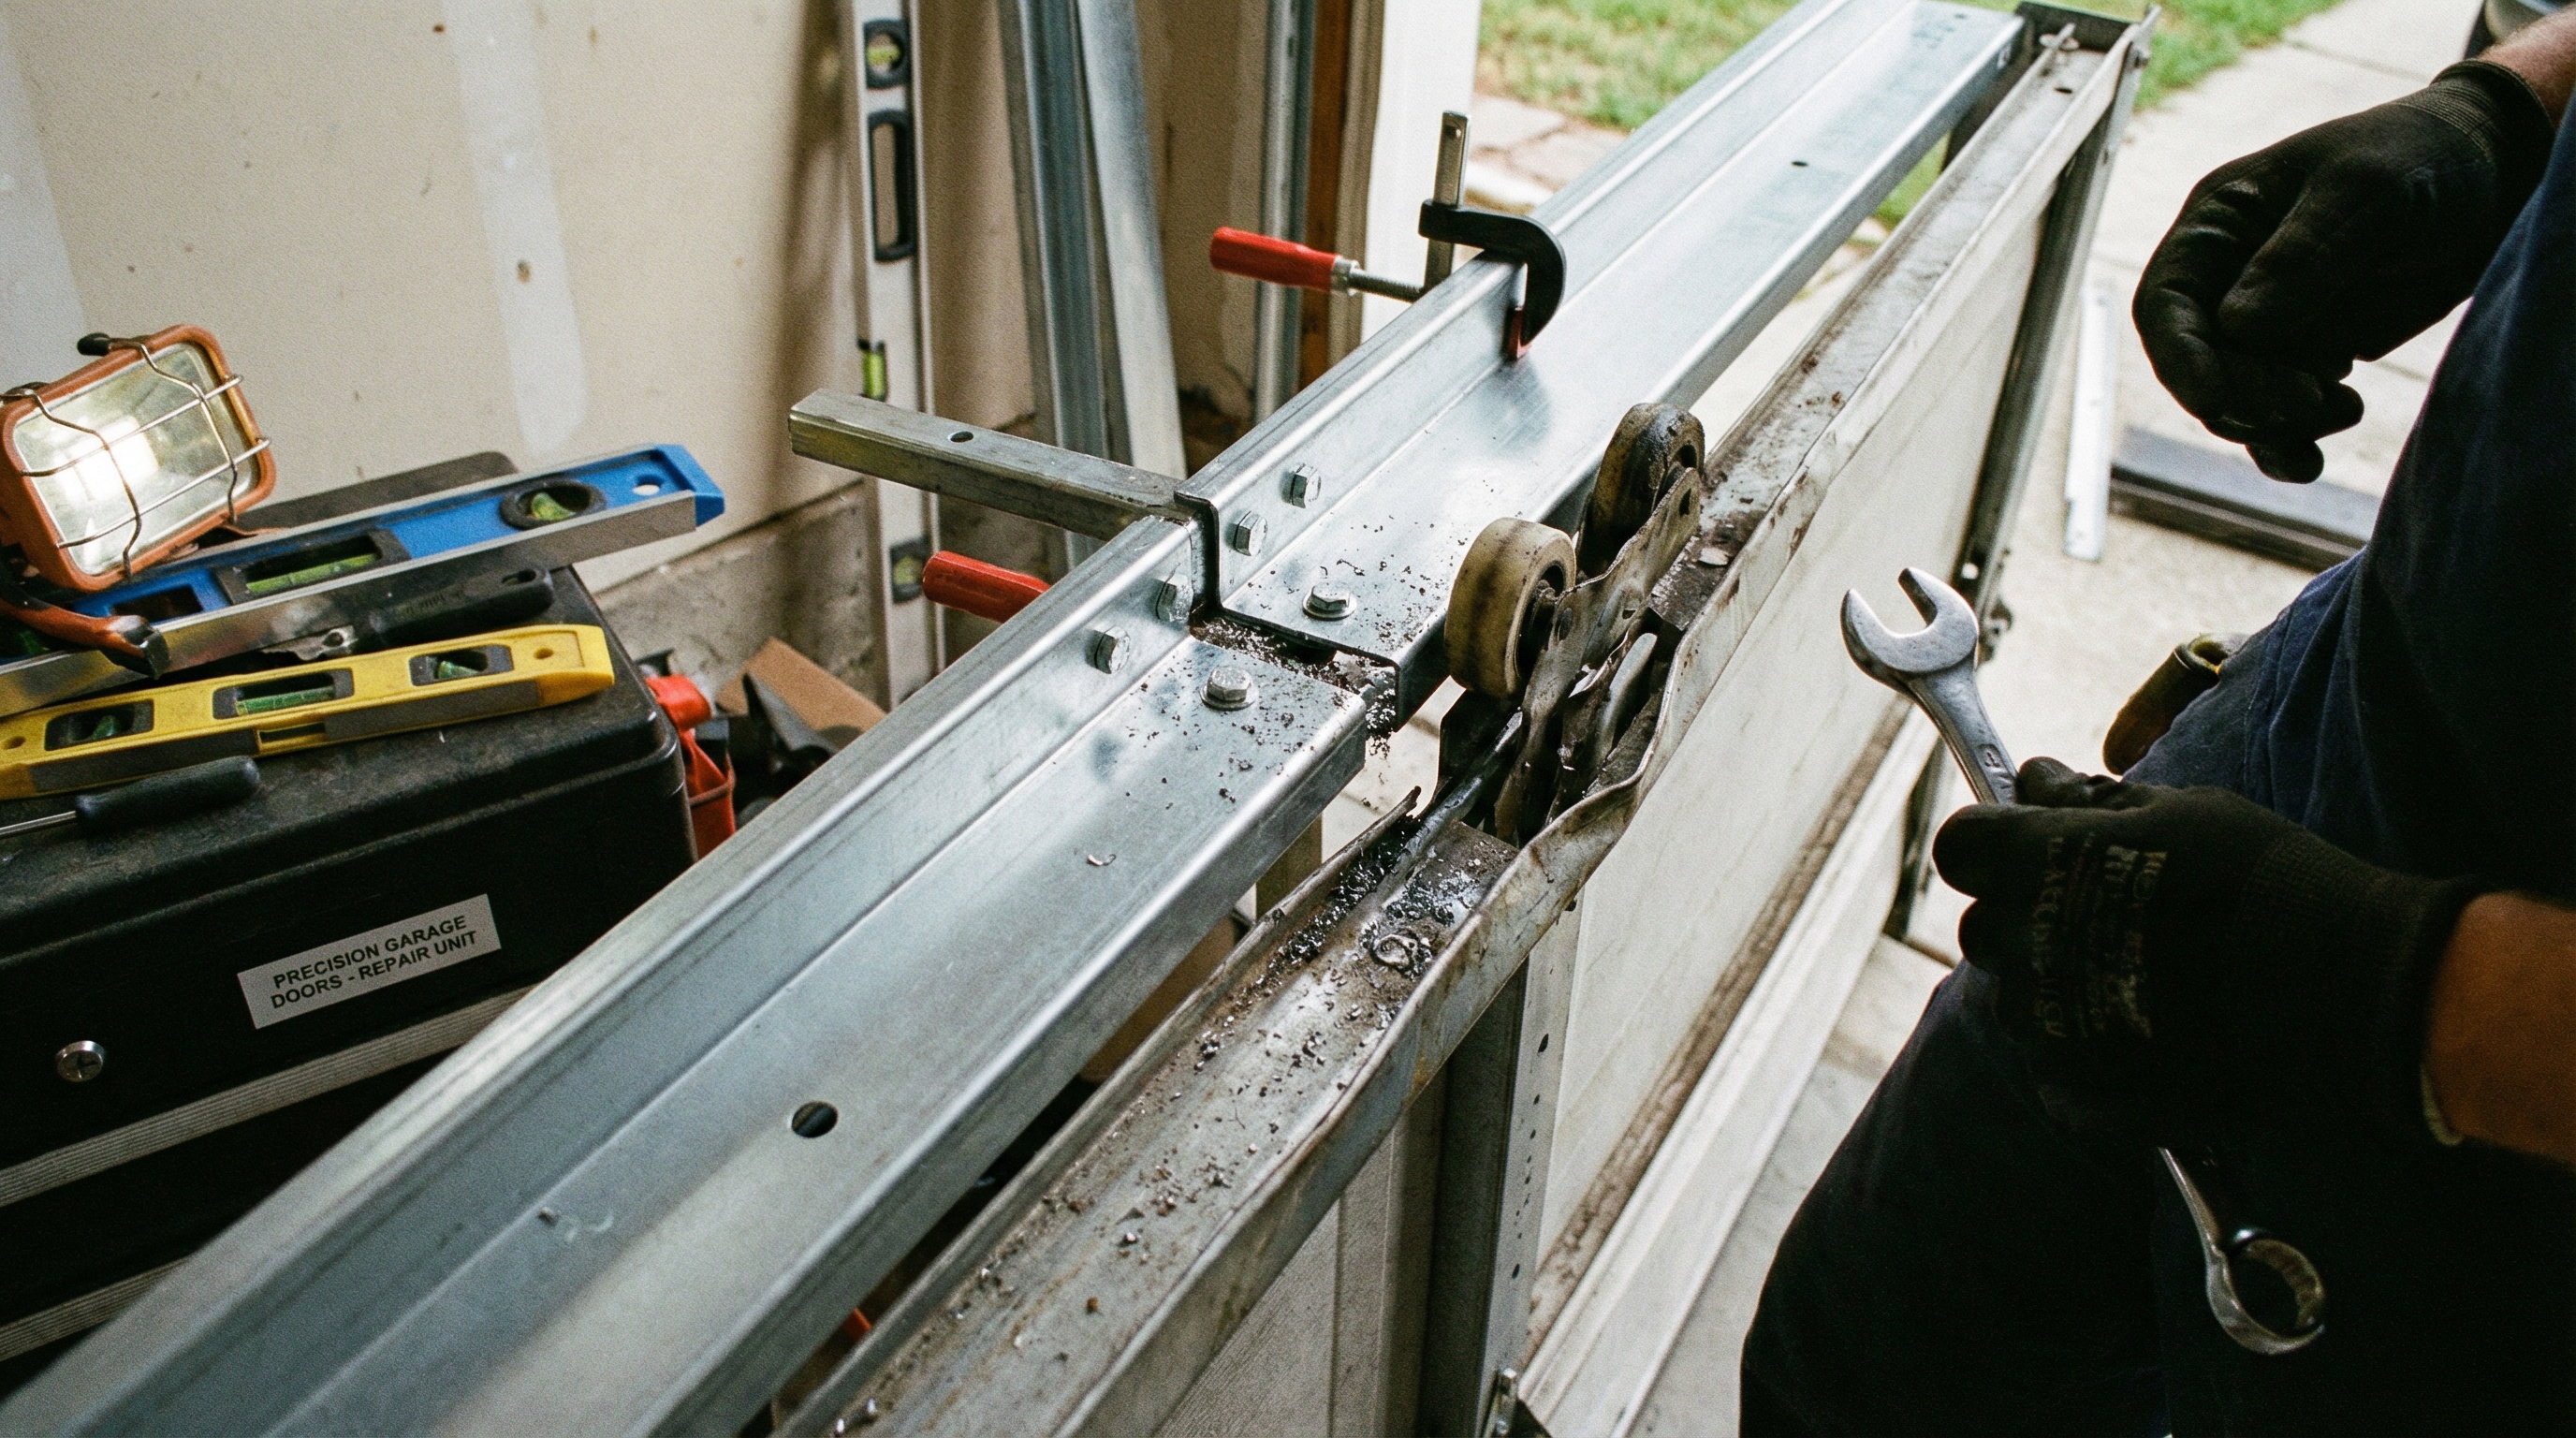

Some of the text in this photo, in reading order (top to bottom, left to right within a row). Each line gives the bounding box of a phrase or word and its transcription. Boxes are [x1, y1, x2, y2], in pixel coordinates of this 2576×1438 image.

[271, 975, 343, 1008] DOORS
[359, 946, 430, 980] REPAIR
[434, 931, 476, 955] UNIT
[272, 915, 466, 989] PRECISION GARAGE
